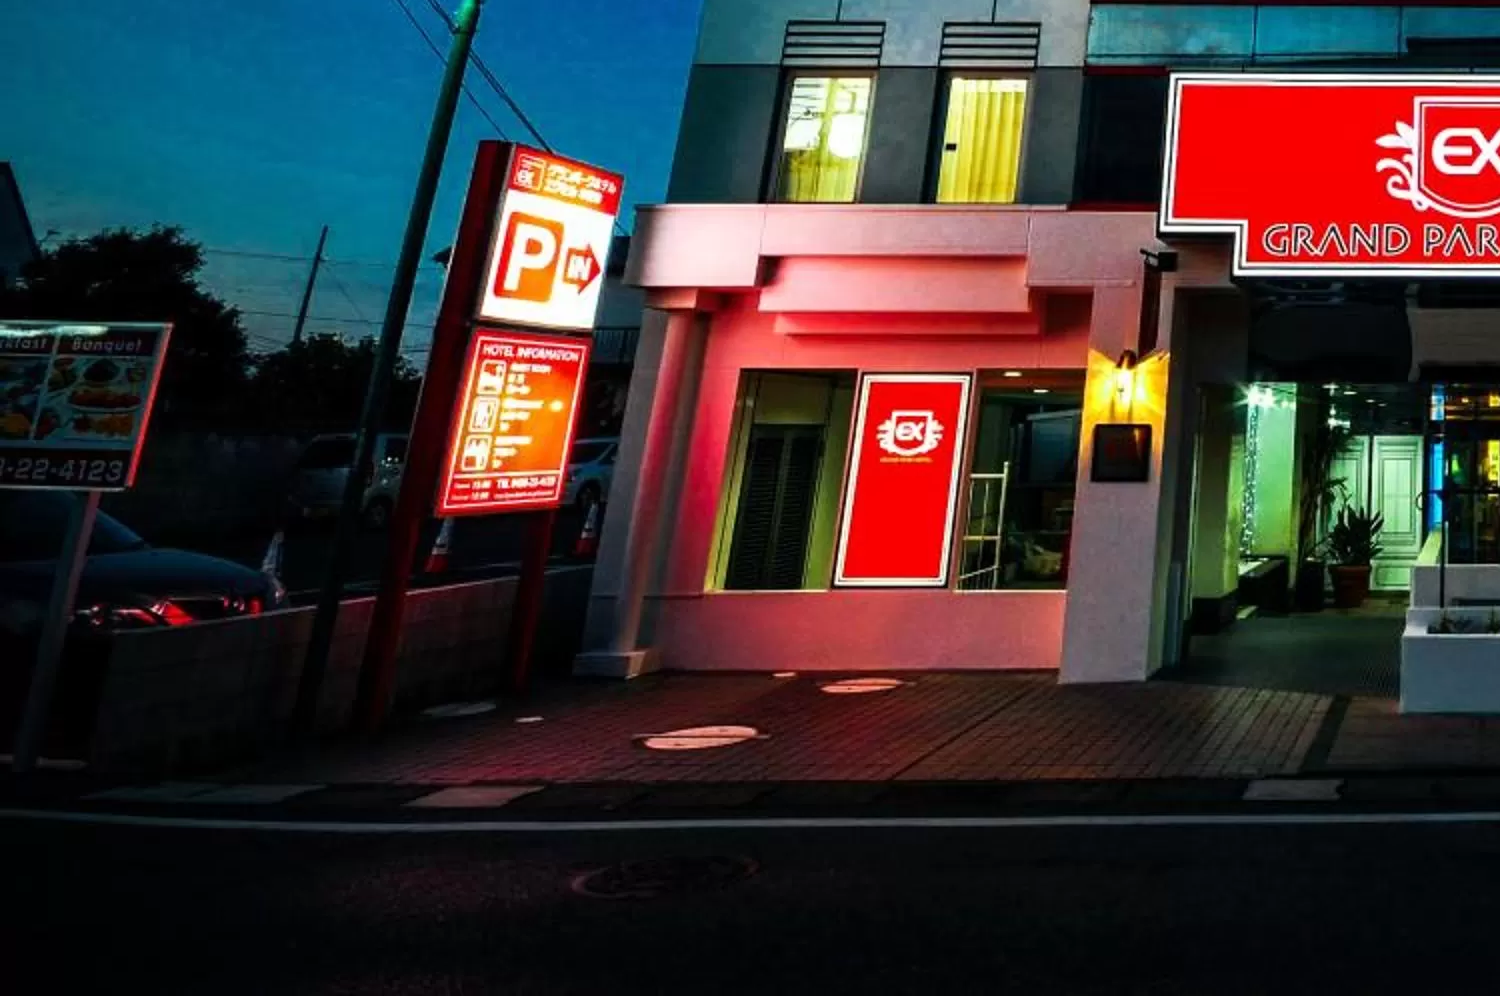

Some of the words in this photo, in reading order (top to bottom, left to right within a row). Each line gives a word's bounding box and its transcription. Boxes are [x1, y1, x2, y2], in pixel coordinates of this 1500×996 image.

[1262, 223, 1411, 257] GRAND
[503, 221, 557, 292] P
[567, 254, 592, 281] IN
[71, 336, 142, 352] Banquet
[482, 344, 514, 358] HOTEL
[895, 421, 925, 442] EX
